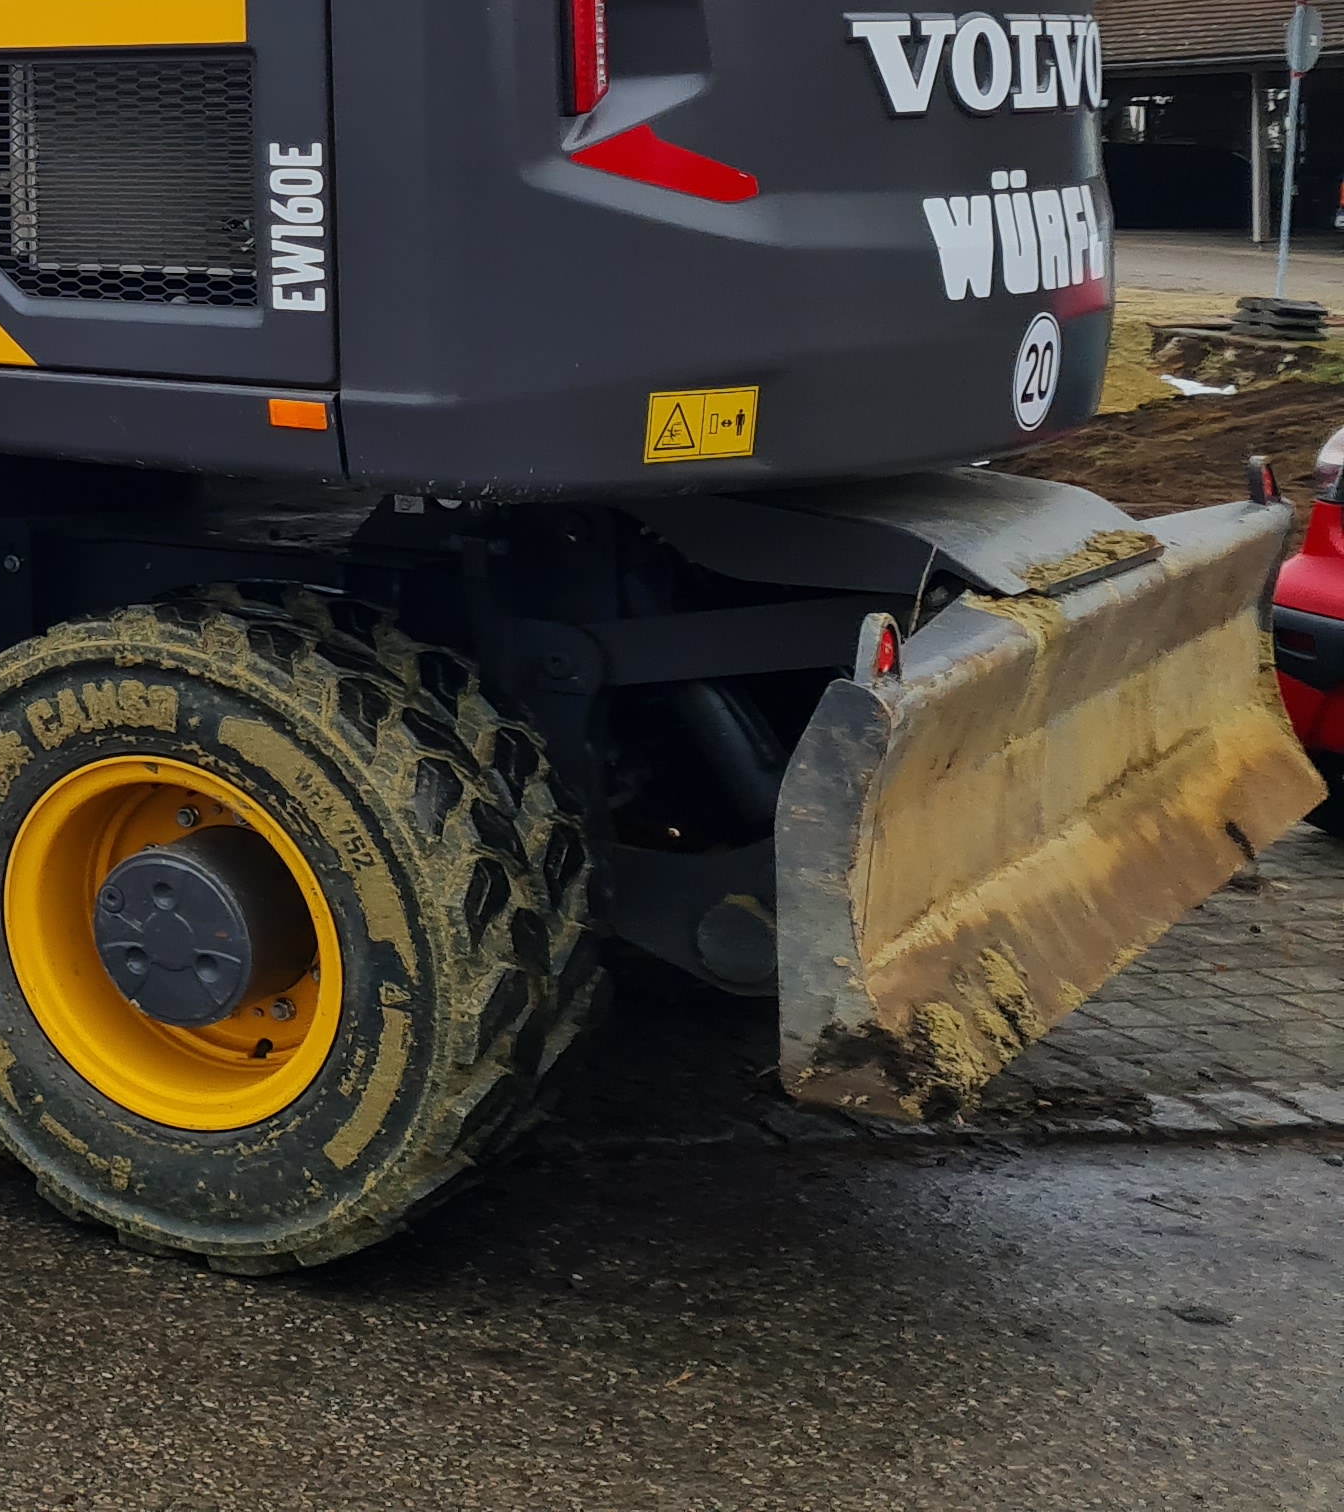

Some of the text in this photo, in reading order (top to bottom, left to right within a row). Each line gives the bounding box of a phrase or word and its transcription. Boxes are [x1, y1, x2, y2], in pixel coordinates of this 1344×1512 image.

[847, 15, 1102, 115] VOLVO
[269, 142, 326, 312] EW160E
[923, 169, 1105, 301] WÜRFL
[1020, 341, 1054, 403] 20
[337, 819, 376, 872] 752
